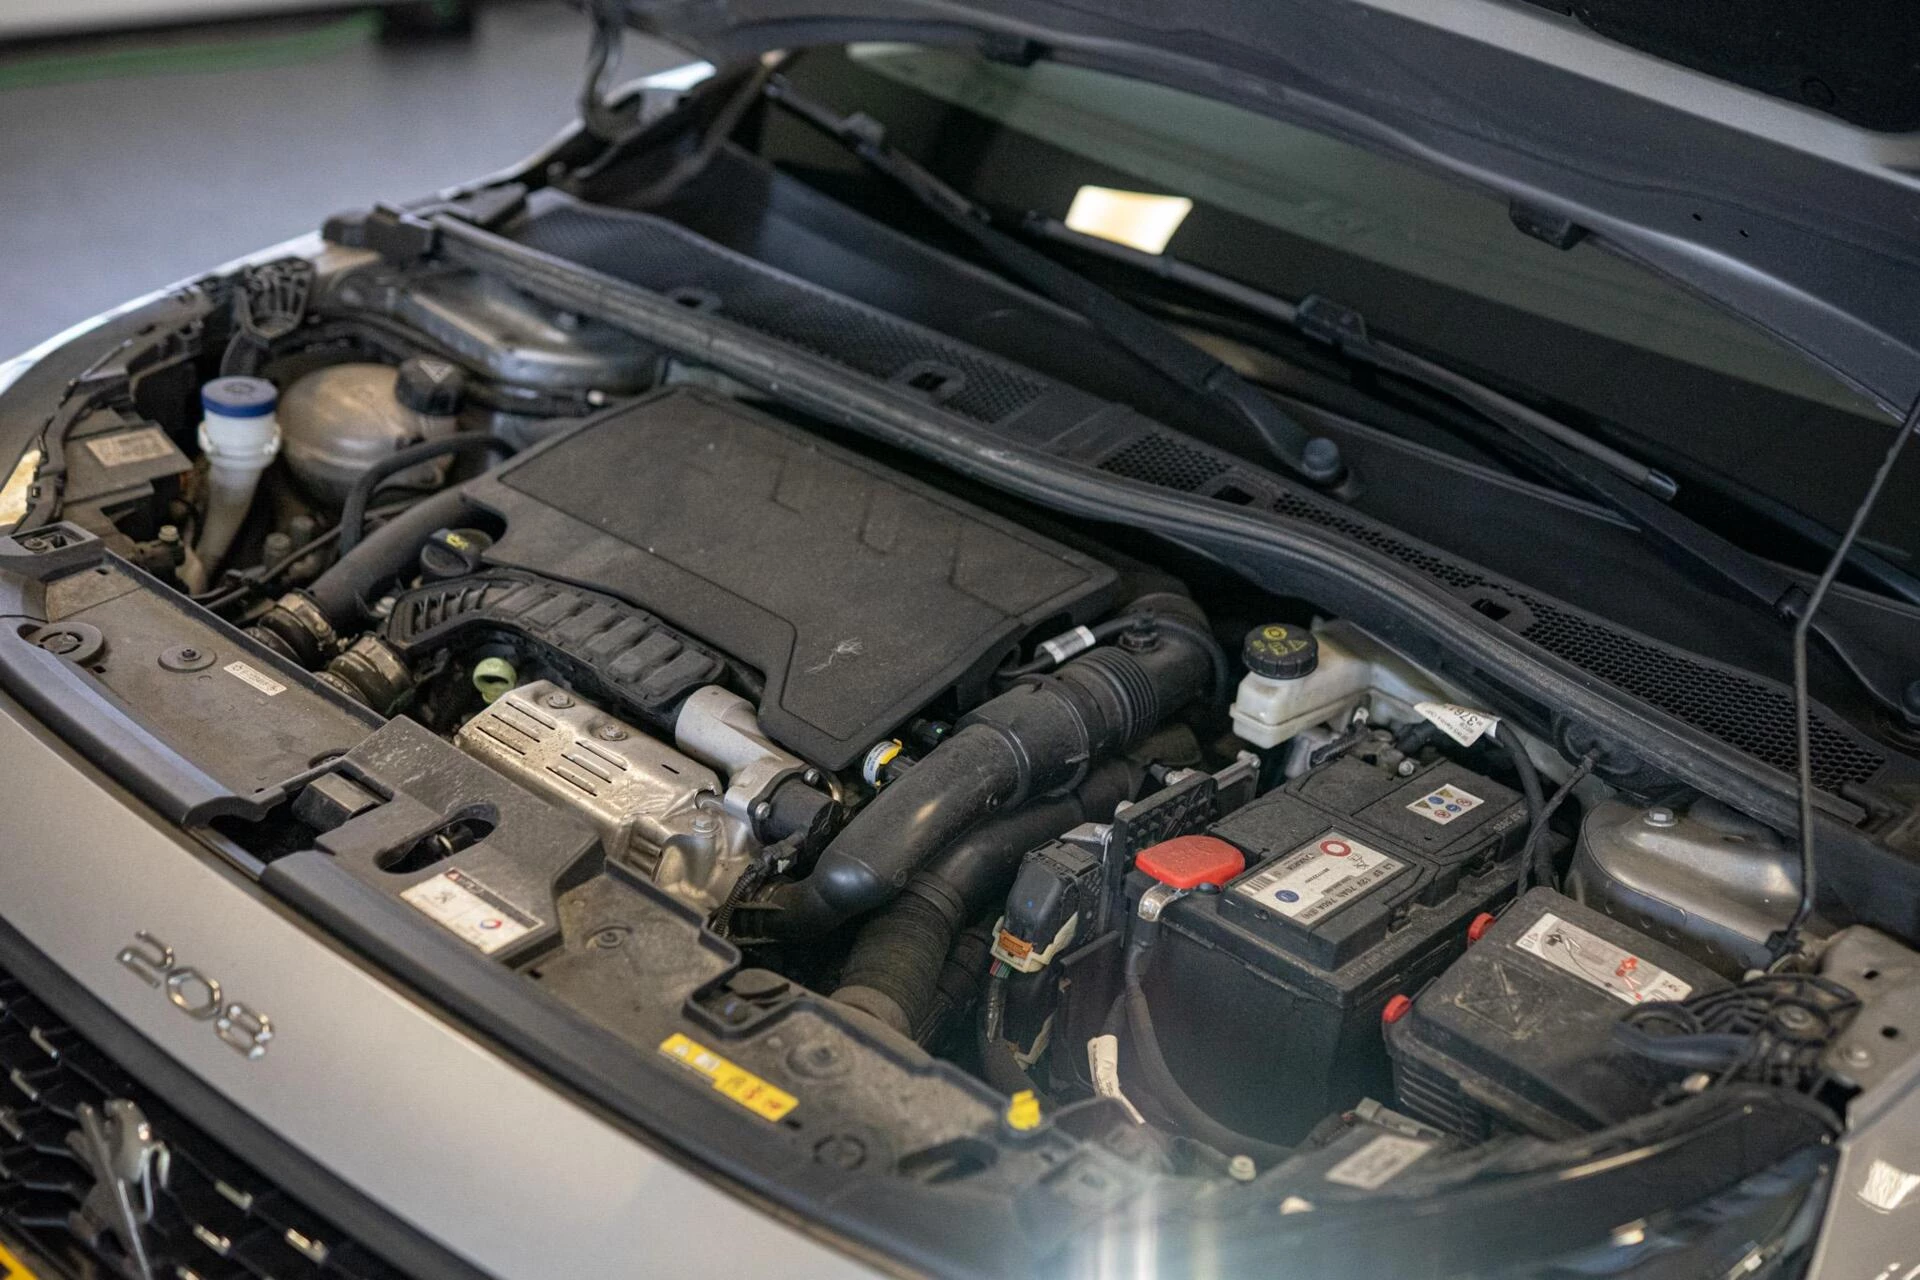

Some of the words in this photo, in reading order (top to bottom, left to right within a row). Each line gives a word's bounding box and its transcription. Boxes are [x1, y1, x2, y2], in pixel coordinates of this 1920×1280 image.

[1356, 877, 1372, 887] 12V
[1336, 886, 1358, 898] 70Ah
[115, 930, 274, 1060] 208
